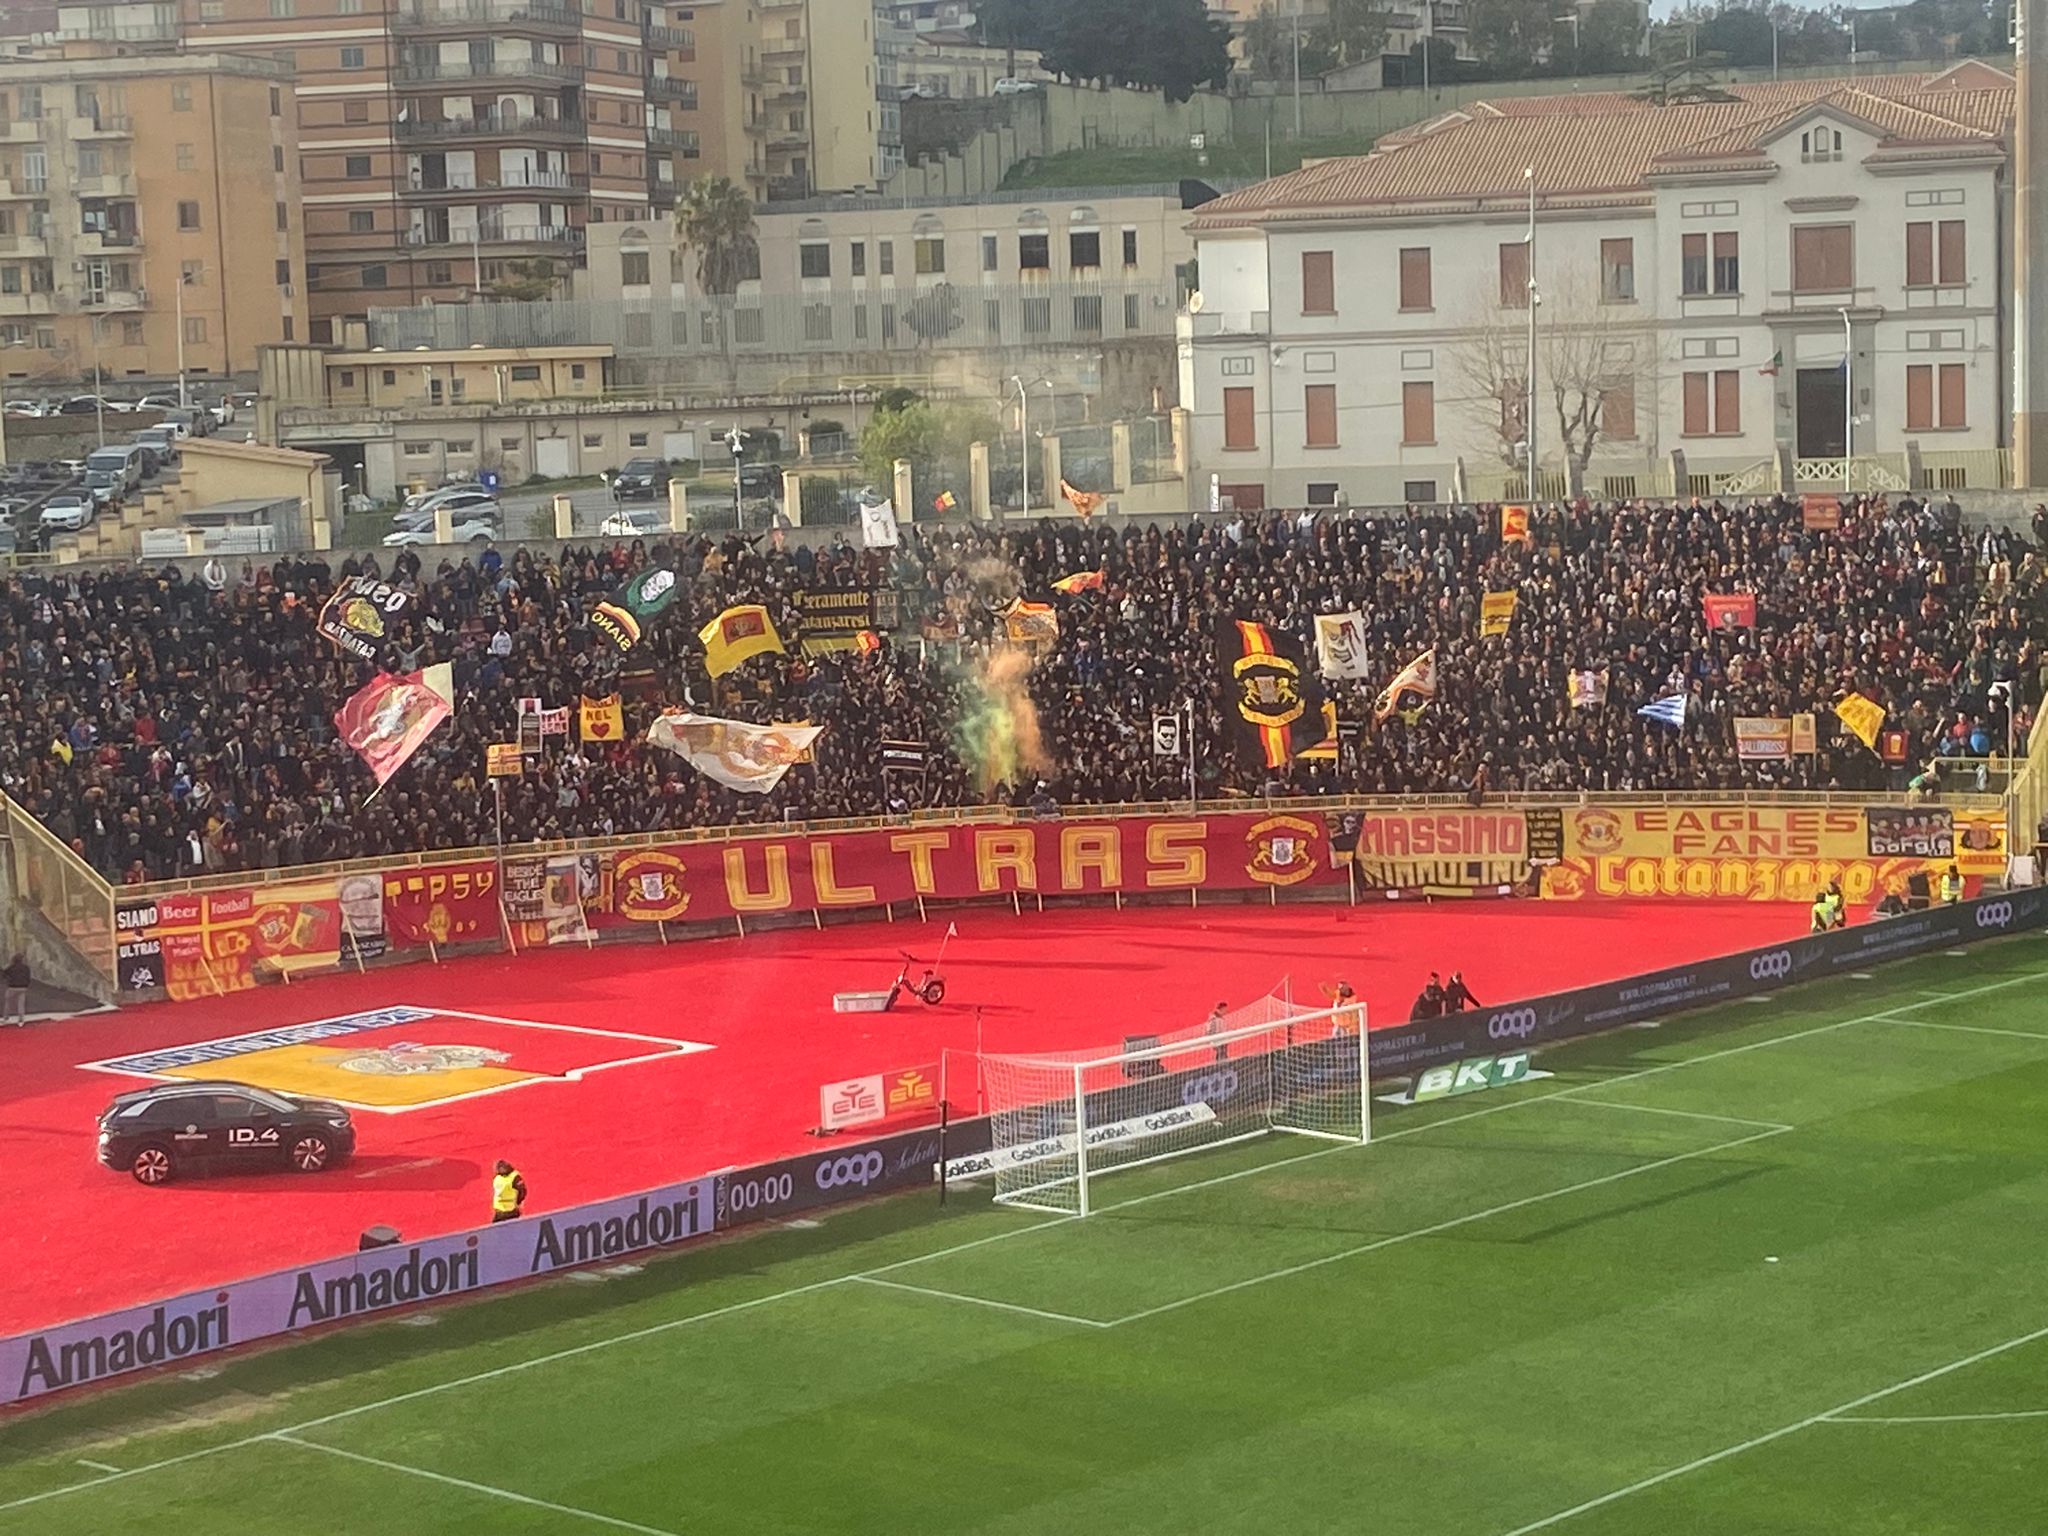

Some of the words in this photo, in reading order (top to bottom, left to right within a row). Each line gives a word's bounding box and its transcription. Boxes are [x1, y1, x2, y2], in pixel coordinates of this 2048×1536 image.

[1362, 816, 1525, 856] MASSIMO
[1635, 810, 1859, 832] EAGLES
[1673, 834, 1819, 856] FANS
[507, 863, 544, 878] BESIDE
[722, 822, 1208, 911] ULTRAS
[1596, 854, 1877, 901] Catanzaro
[513, 878, 540, 890] THE
[117, 906, 158, 929] SIANO
[162, 906, 198, 920] Beer
[1976, 901, 2013, 929] coop
[119, 939, 160, 958] ULTRAS
[1750, 949, 1792, 981] coop
[1488, 1007, 1537, 1040] coop
[1418, 1053, 1528, 1093] BKT
[228, 1127, 280, 1143] ID.4
[1144, 1109, 1195, 1131] GoldBet
[815, 1150, 884, 1190] coop
[730, 1172, 793, 1212] 00:00
[531, 1185, 700, 1272] Amadori
[287, 1235, 480, 1328] Amadori
[19, 1292, 231, 1398] Amadori
